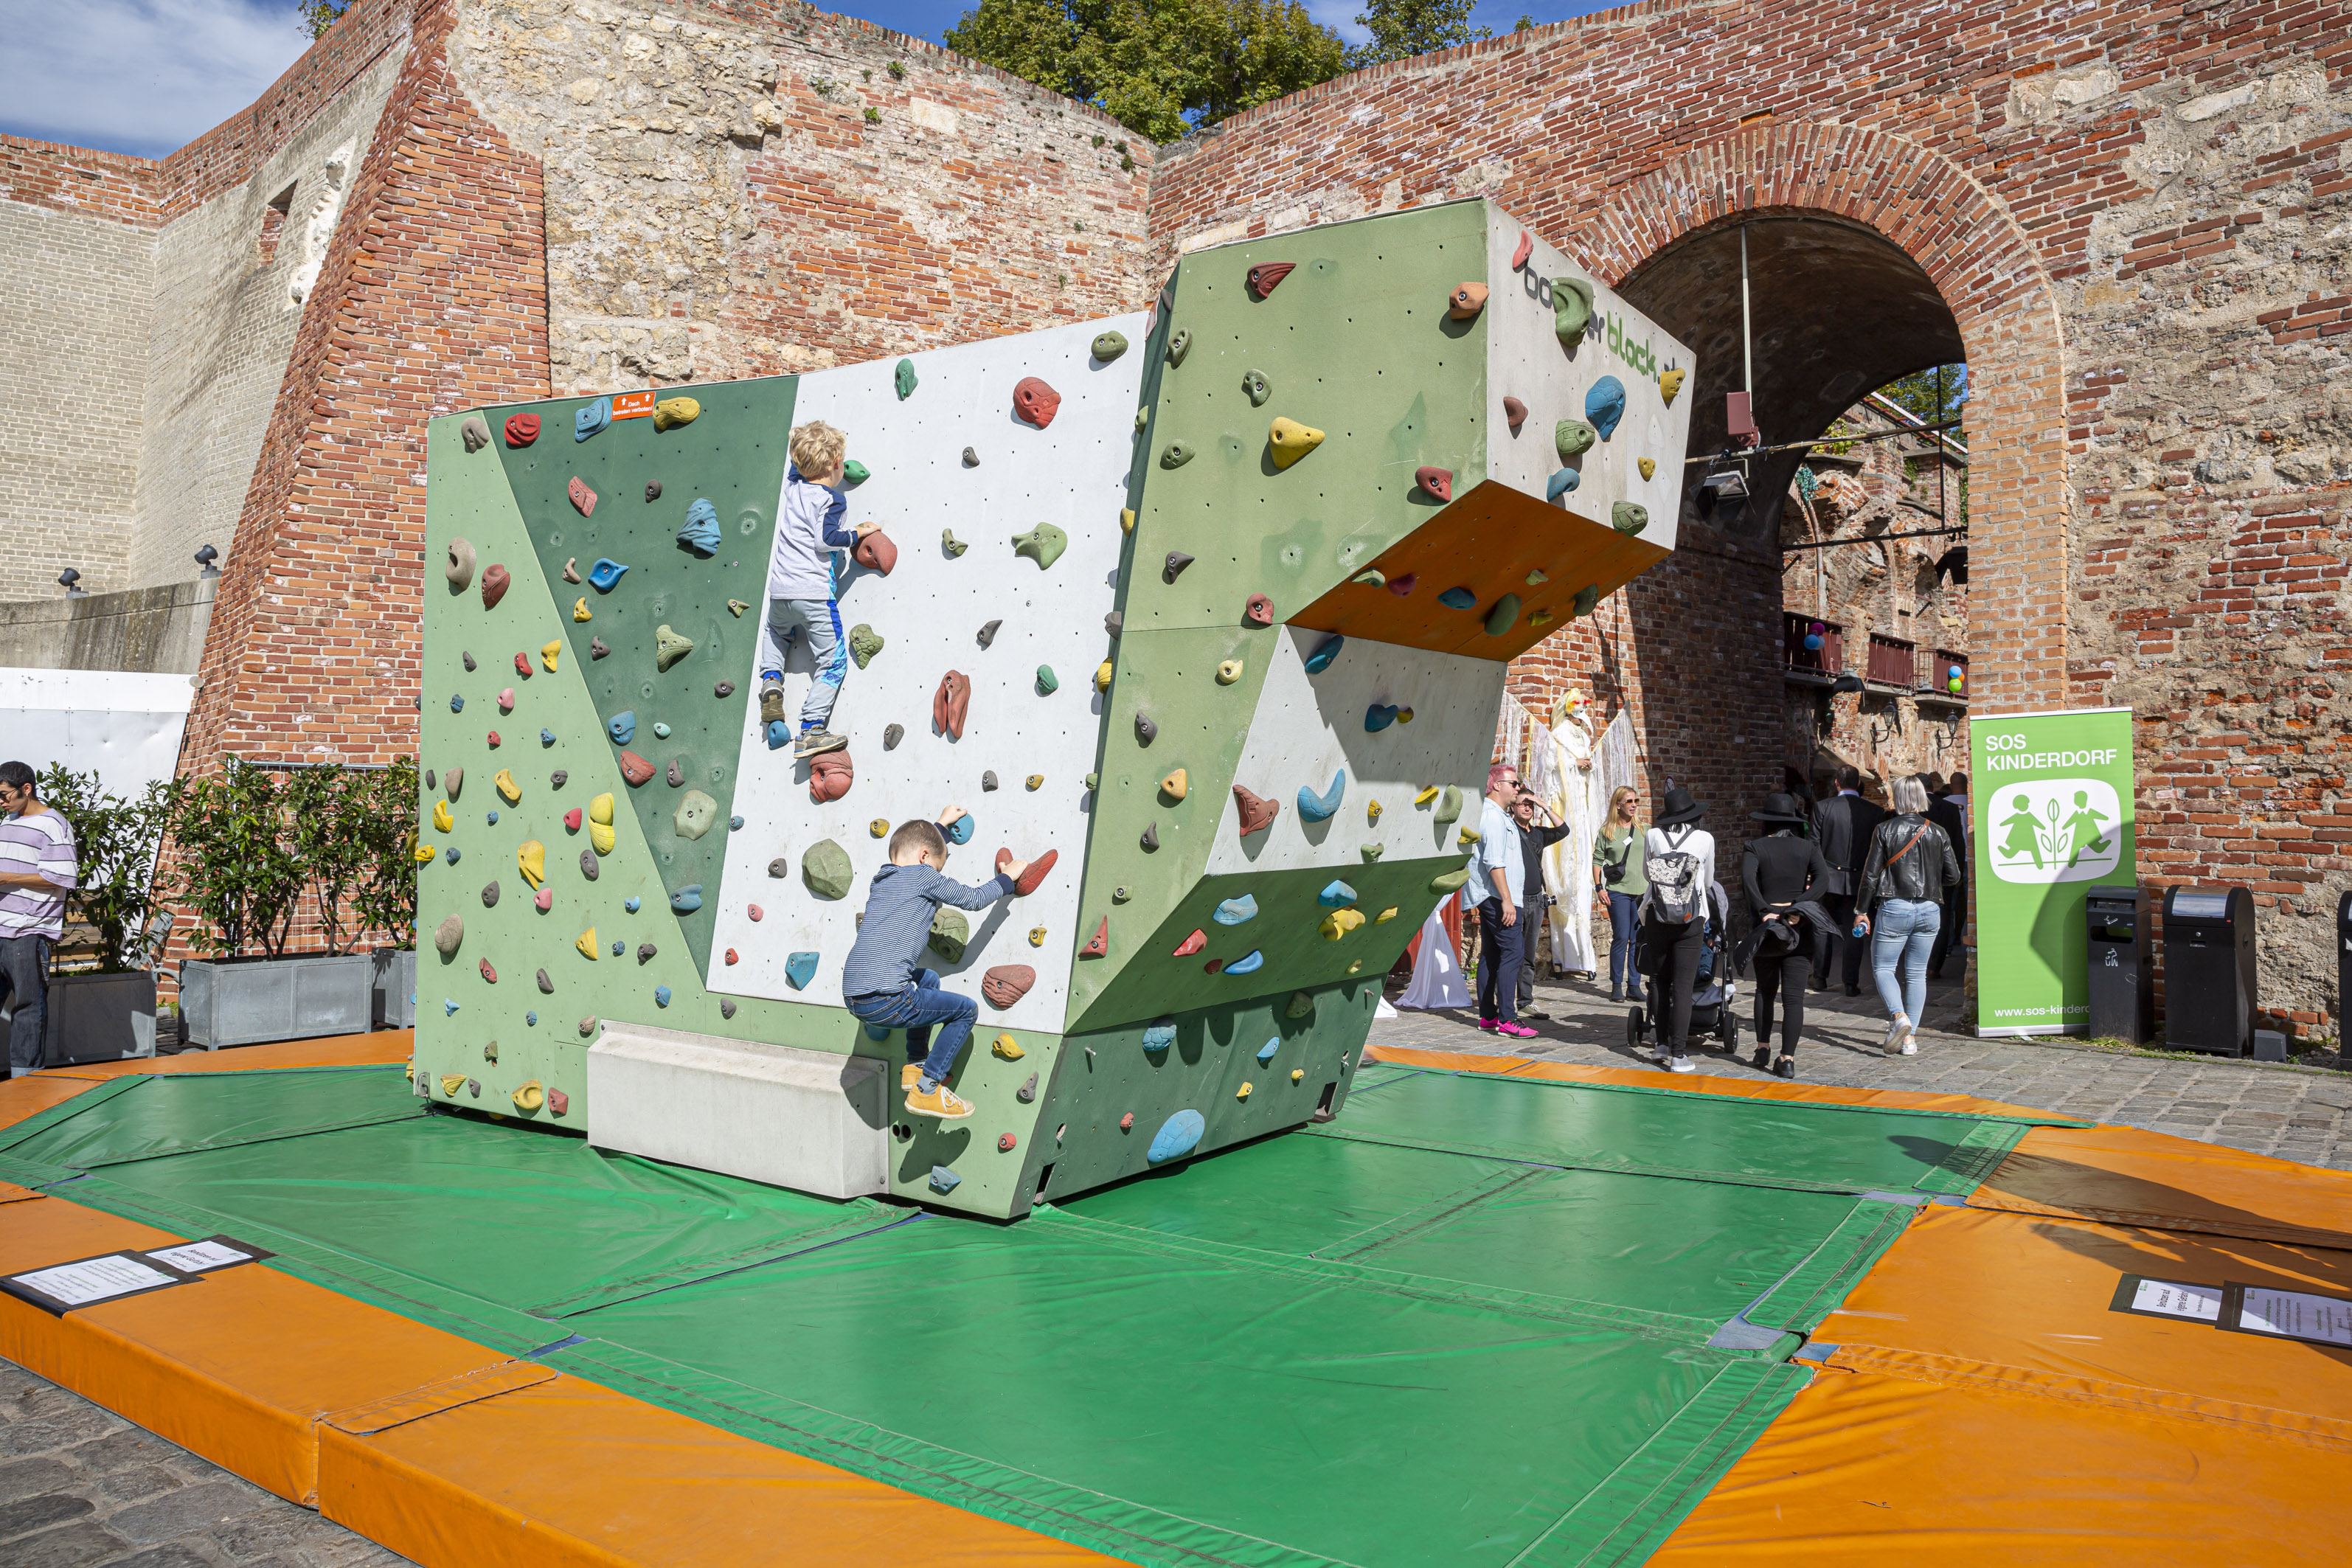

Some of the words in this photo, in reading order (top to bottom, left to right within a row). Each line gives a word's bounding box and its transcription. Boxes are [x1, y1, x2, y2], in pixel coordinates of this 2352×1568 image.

[631, 405, 653, 413] verboten!
[1985, 734, 2027, 752] SOS
[1987, 749, 2117, 771] KINDERDORF
